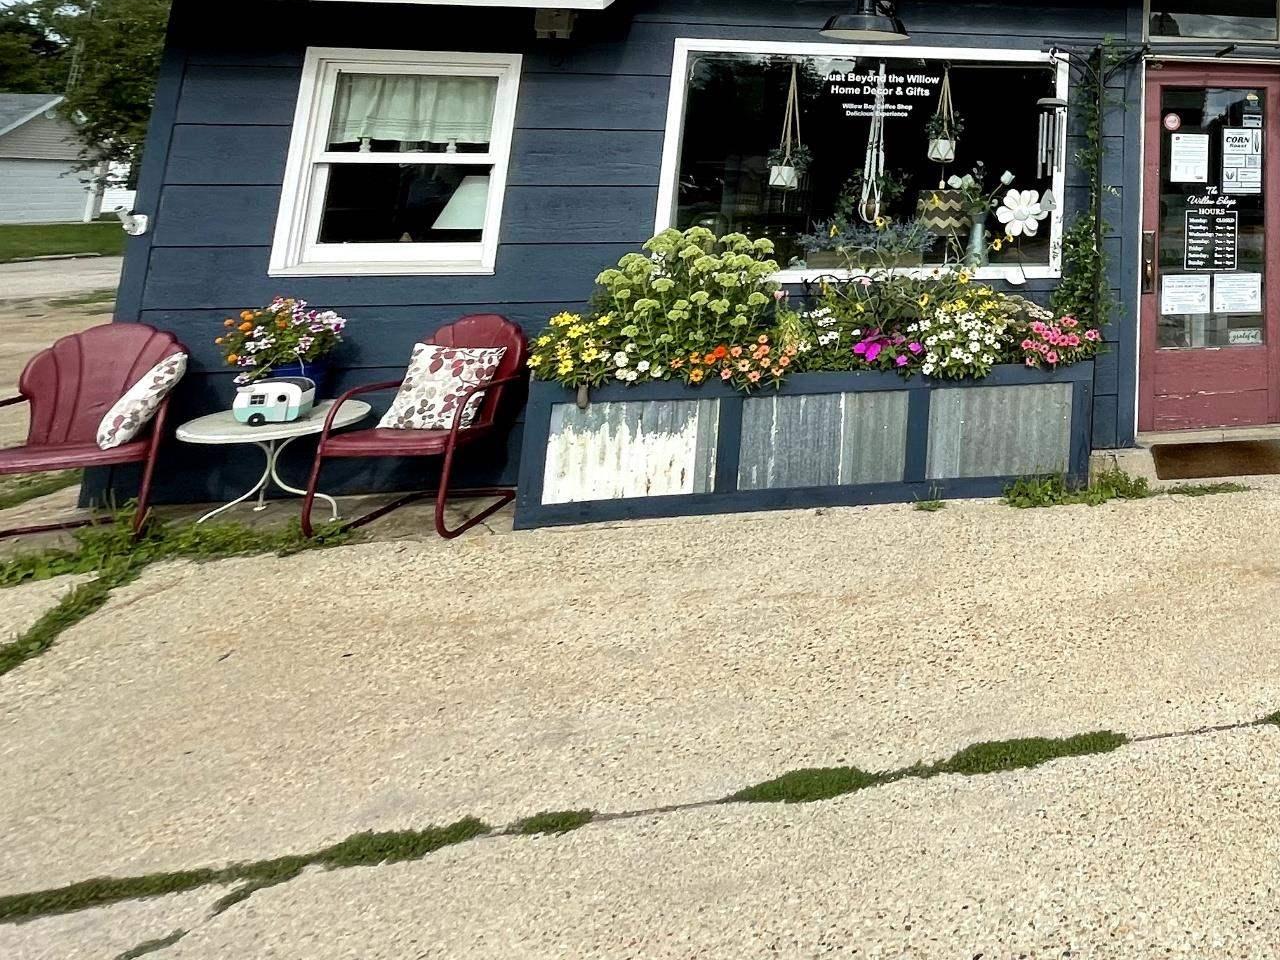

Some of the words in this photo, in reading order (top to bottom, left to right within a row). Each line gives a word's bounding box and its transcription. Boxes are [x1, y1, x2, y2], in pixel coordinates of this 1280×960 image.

[823, 73, 845, 81] Just
[848, 73, 886, 83] Beyond
[888, 74, 904, 83] the
[907, 74, 940, 84] Willow
[831, 85, 860, 94] Home
[863, 85, 893, 95] Decor
[895, 87, 903, 95] &
[906, 87, 930, 96] Gifts
